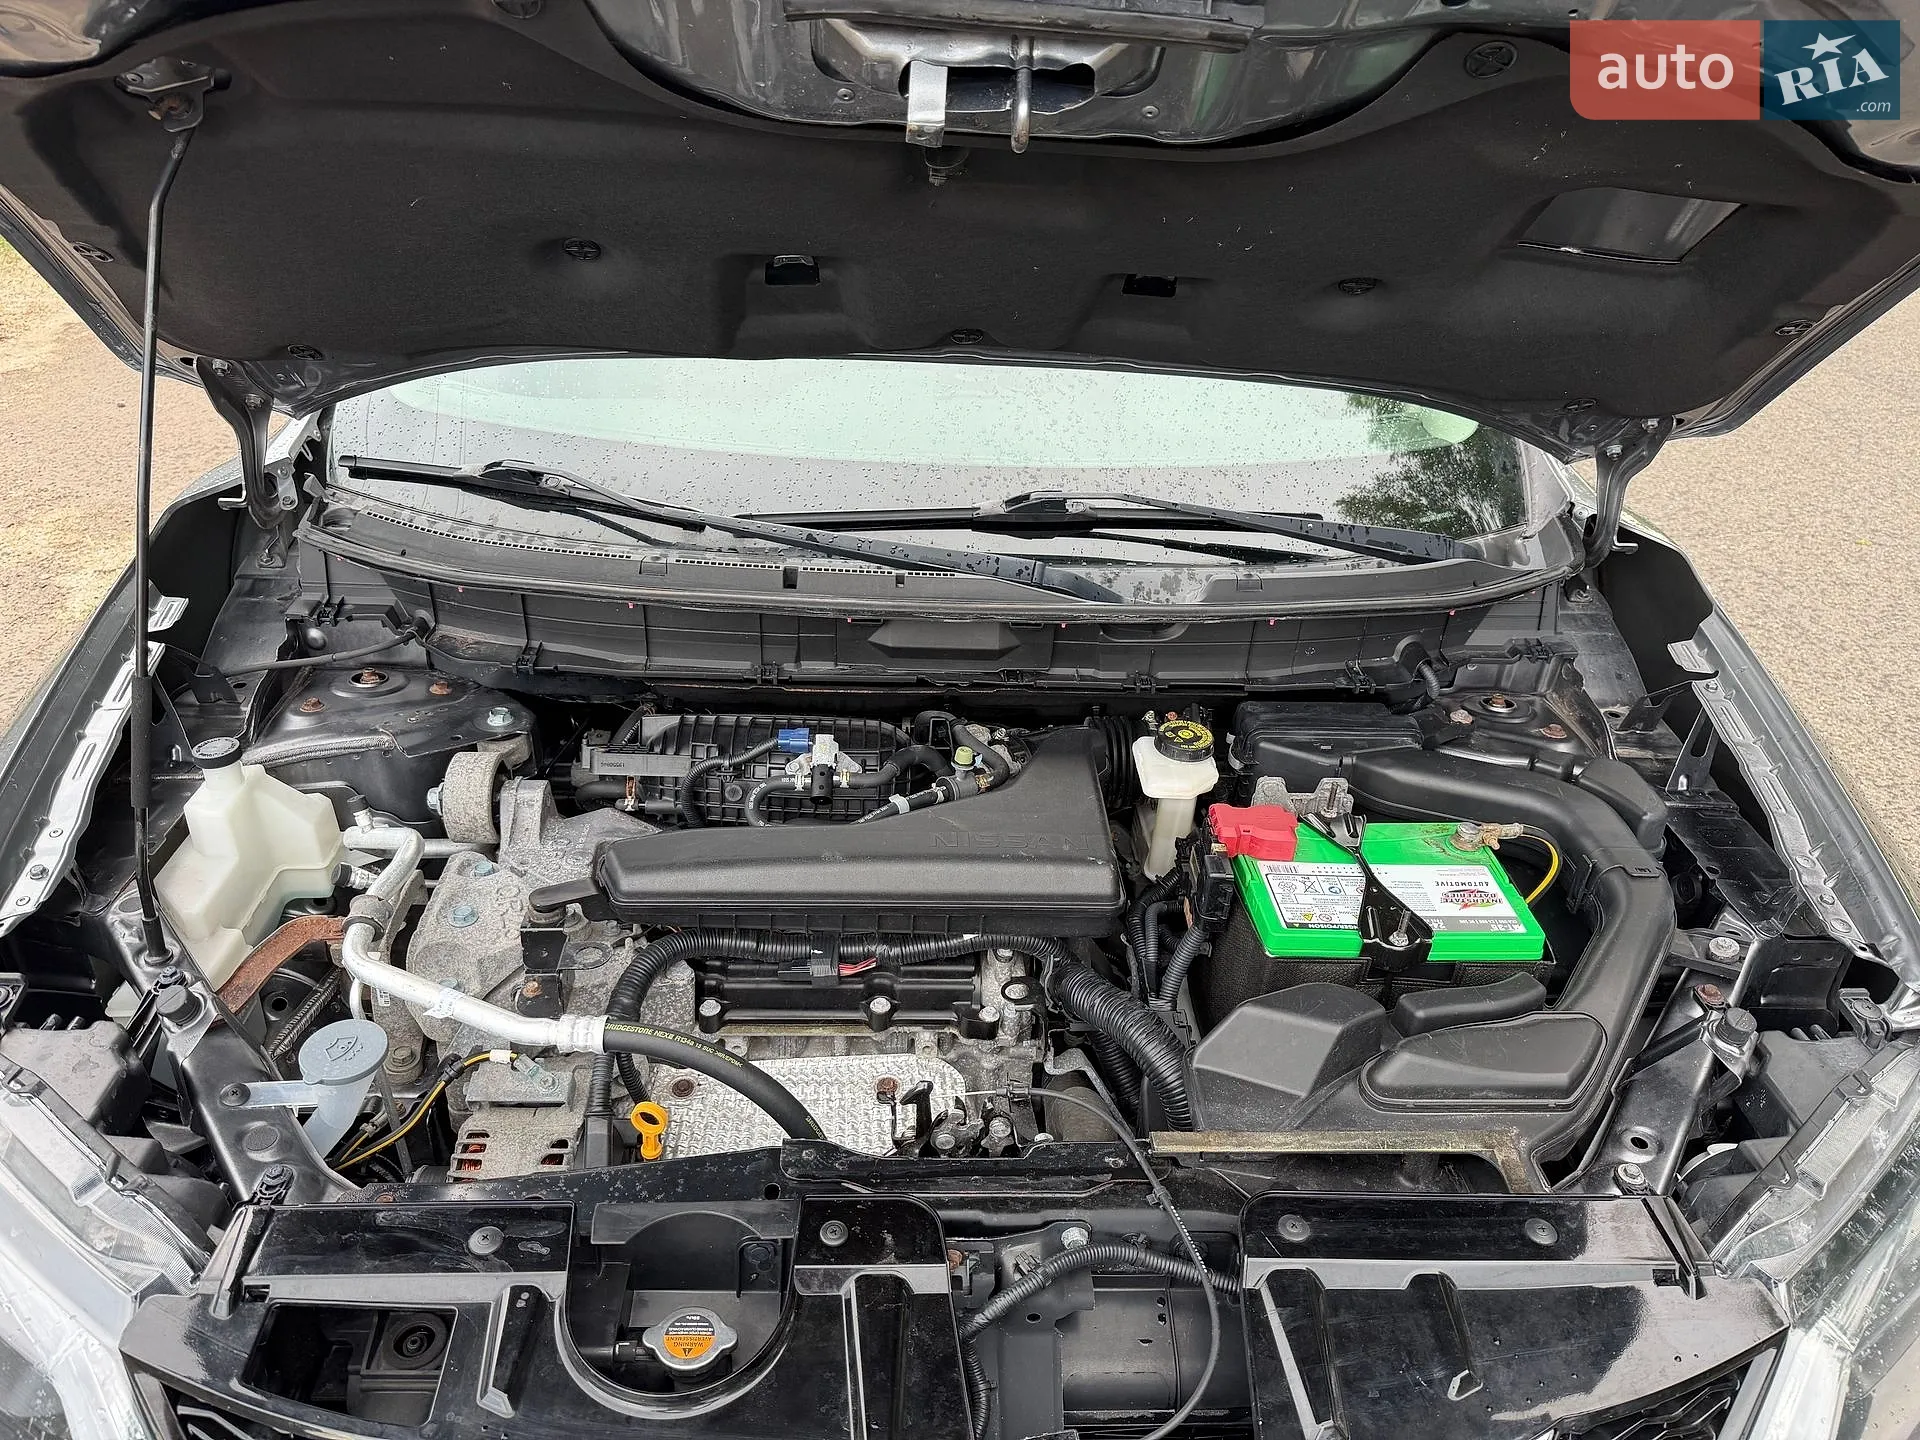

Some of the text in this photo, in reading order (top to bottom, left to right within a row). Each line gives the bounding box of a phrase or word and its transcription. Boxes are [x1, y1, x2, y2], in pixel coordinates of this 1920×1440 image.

[929, 831, 1090, 850] NISSAN
[1307, 922, 1358, 930] NGER/POISON
[604, 1022, 653, 1036] BRIDGESTONE
